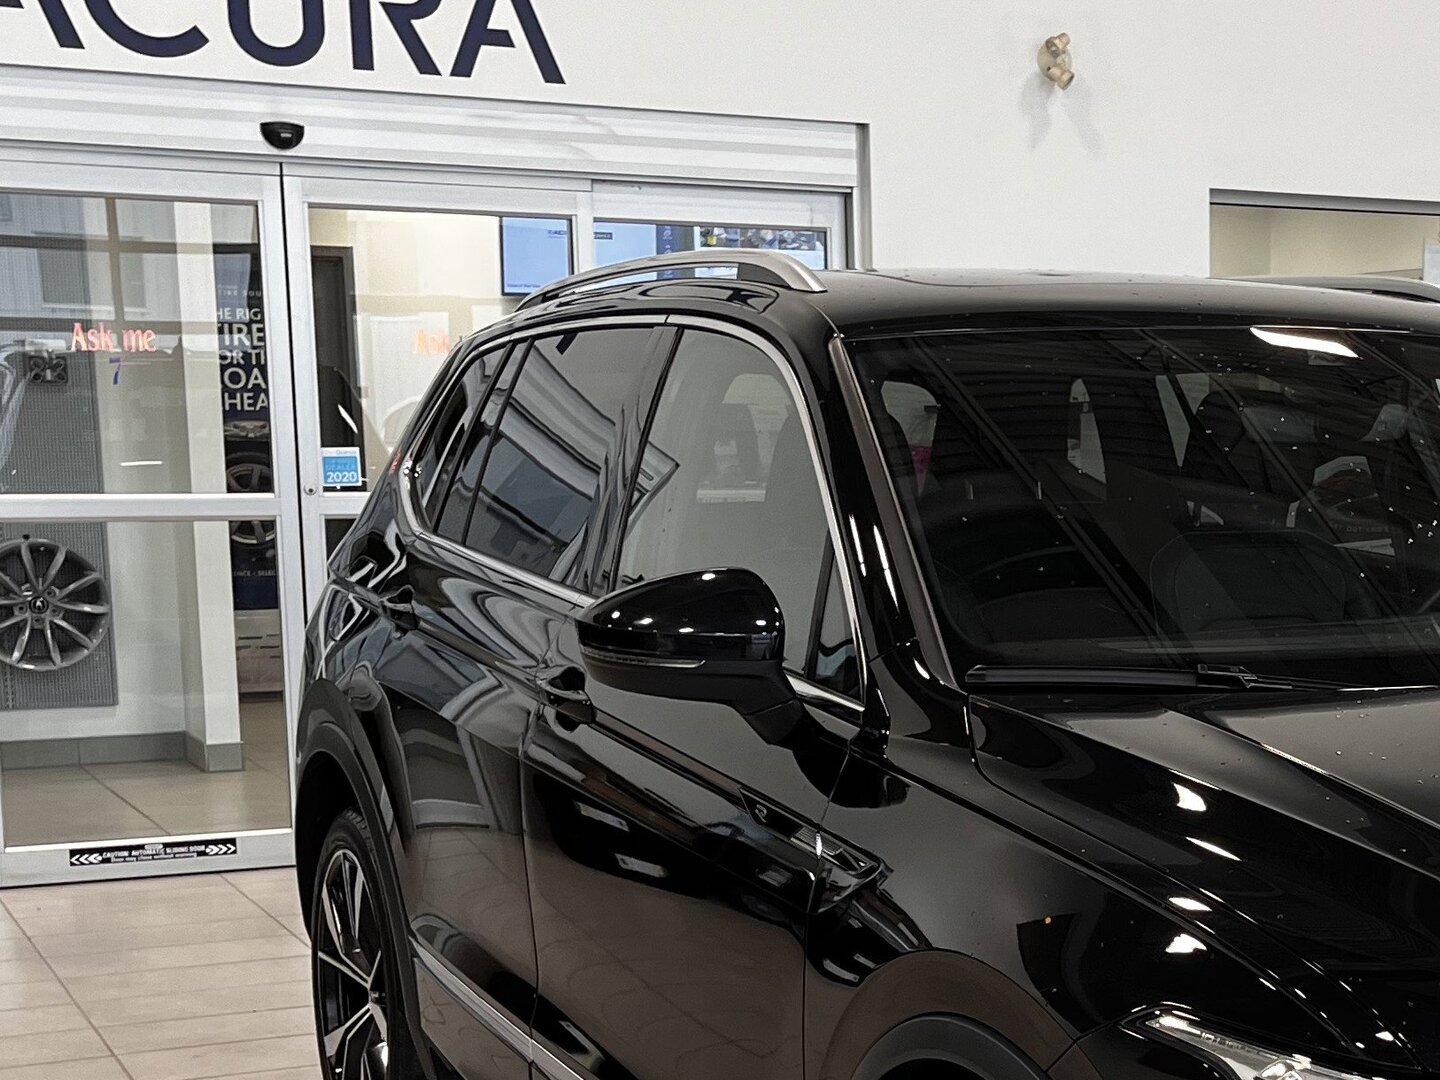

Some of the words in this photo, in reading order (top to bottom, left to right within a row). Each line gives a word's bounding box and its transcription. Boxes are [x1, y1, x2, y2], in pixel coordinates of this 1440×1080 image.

[71, 321, 115, 352] Ask
[122, 328, 157, 353] me
[219, 349, 245, 365] OR
[327, 472, 357, 482] 2020
